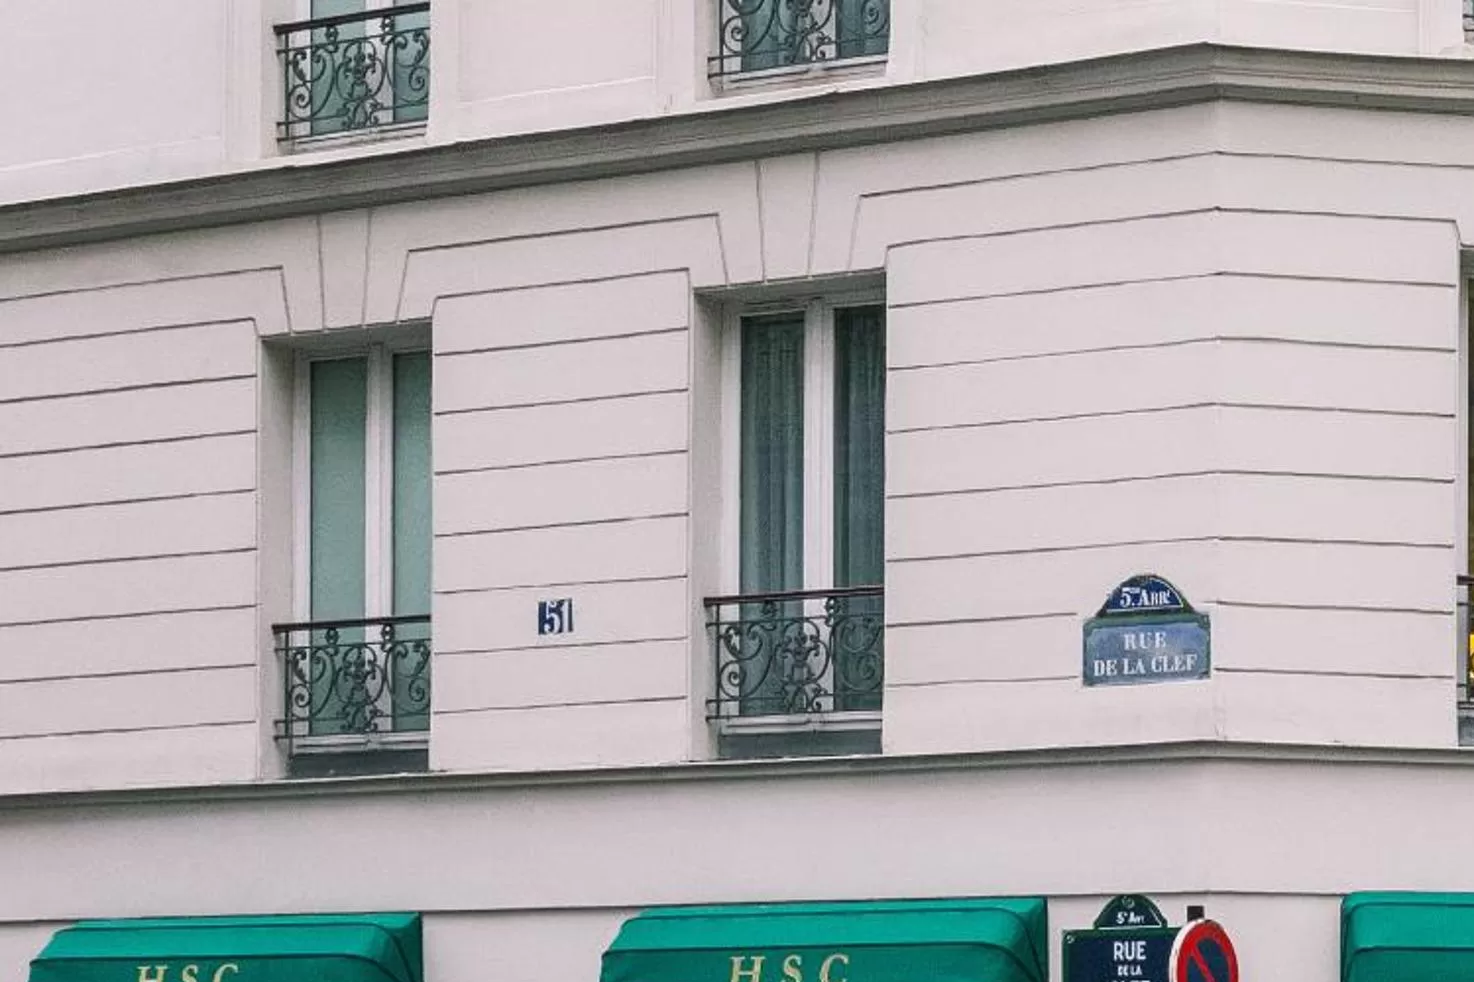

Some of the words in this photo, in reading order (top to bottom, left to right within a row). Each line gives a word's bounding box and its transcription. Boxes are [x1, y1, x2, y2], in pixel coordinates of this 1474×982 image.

[544, 603, 570, 634] 51
[1123, 632, 1166, 650] RUE
[1094, 659, 1117, 676] DE
[1122, 658, 1146, 675] LA
[1151, 654, 1198, 672] CLEF
[1113, 941, 1147, 961] RUE
[1117, 964, 1129, 977] DE
[1130, 964, 1143, 976] LA
